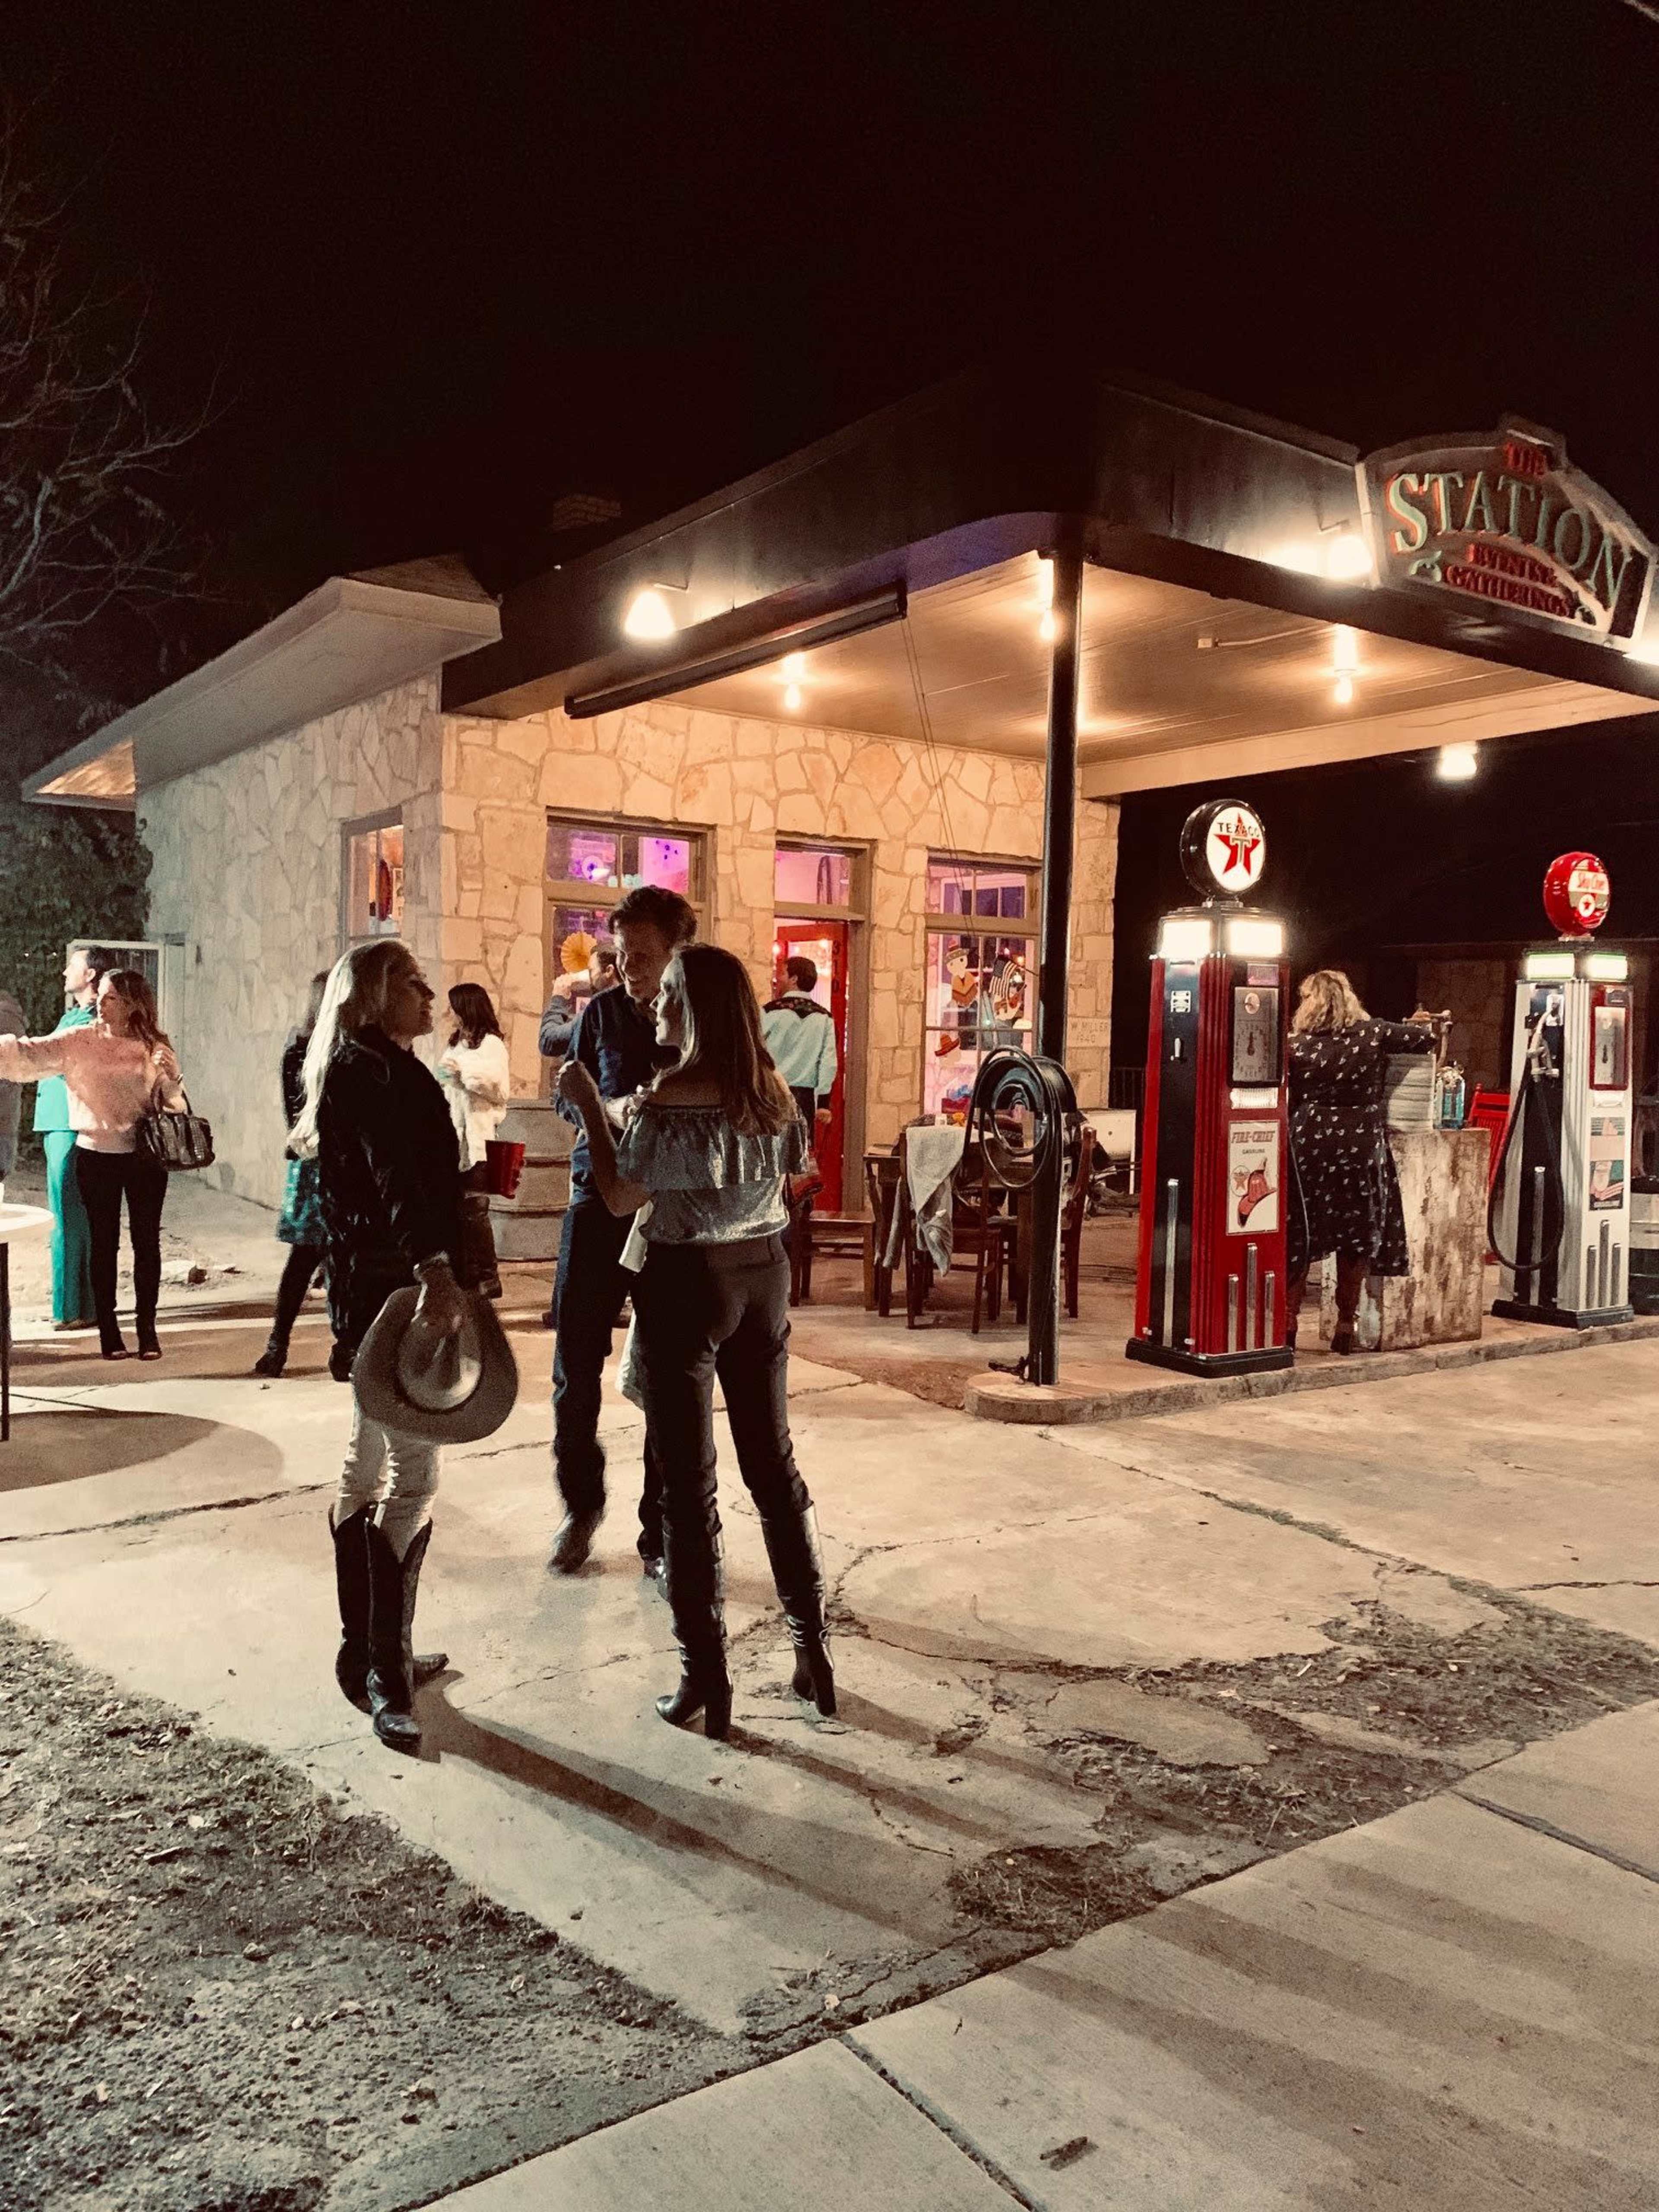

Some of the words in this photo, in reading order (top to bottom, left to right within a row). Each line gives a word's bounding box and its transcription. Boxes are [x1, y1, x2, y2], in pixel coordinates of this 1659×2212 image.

[1385, 470, 1633, 609] STATION
[1217, 822, 1259, 837] TEXACO
[1231, 1130, 1276, 1144] FIRE-CHIEF
